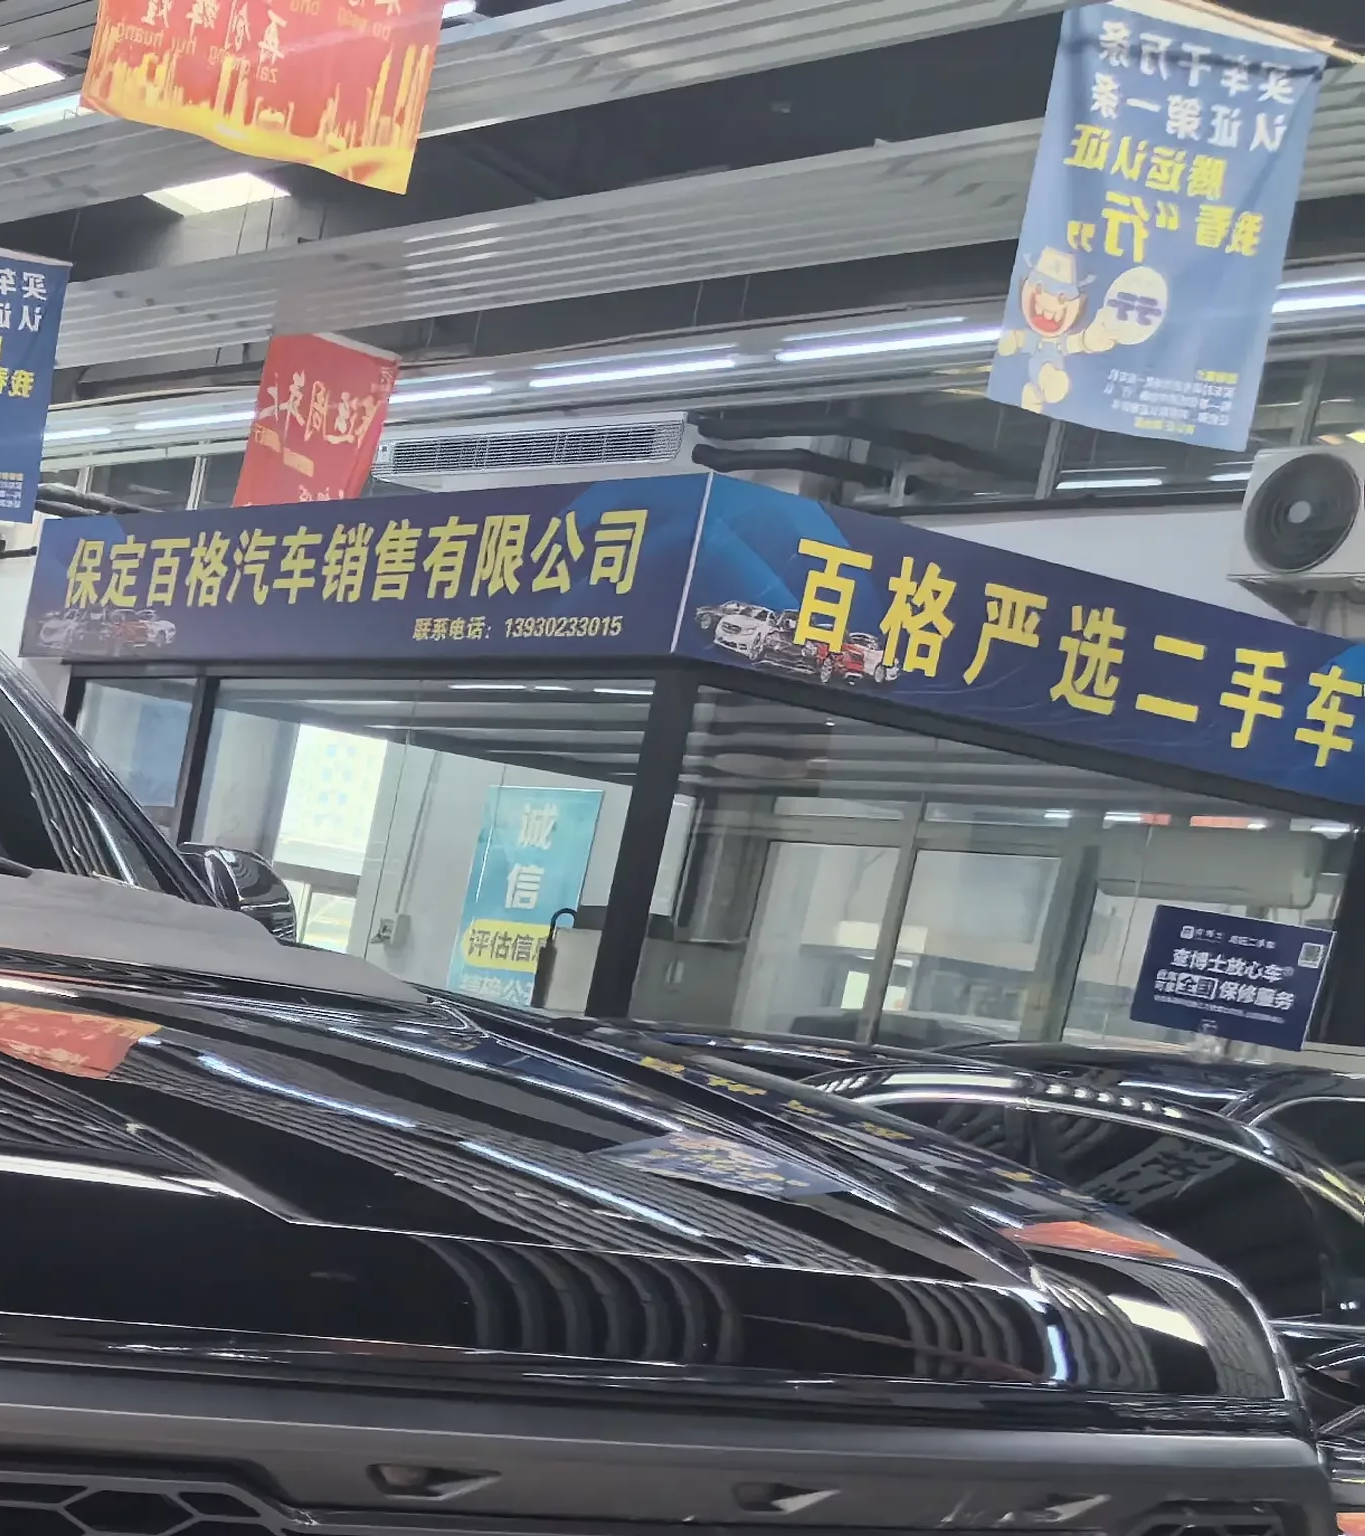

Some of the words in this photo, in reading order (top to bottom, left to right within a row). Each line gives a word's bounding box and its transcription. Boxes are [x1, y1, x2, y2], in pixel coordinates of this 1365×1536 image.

[64, 507, 649, 608] 保定百格汽车销售有限公司
[504, 615, 624, 639] 13930233015
[789, 537, 1363, 768] 百格严选二手车
[504, 802, 559, 910] 诚信
